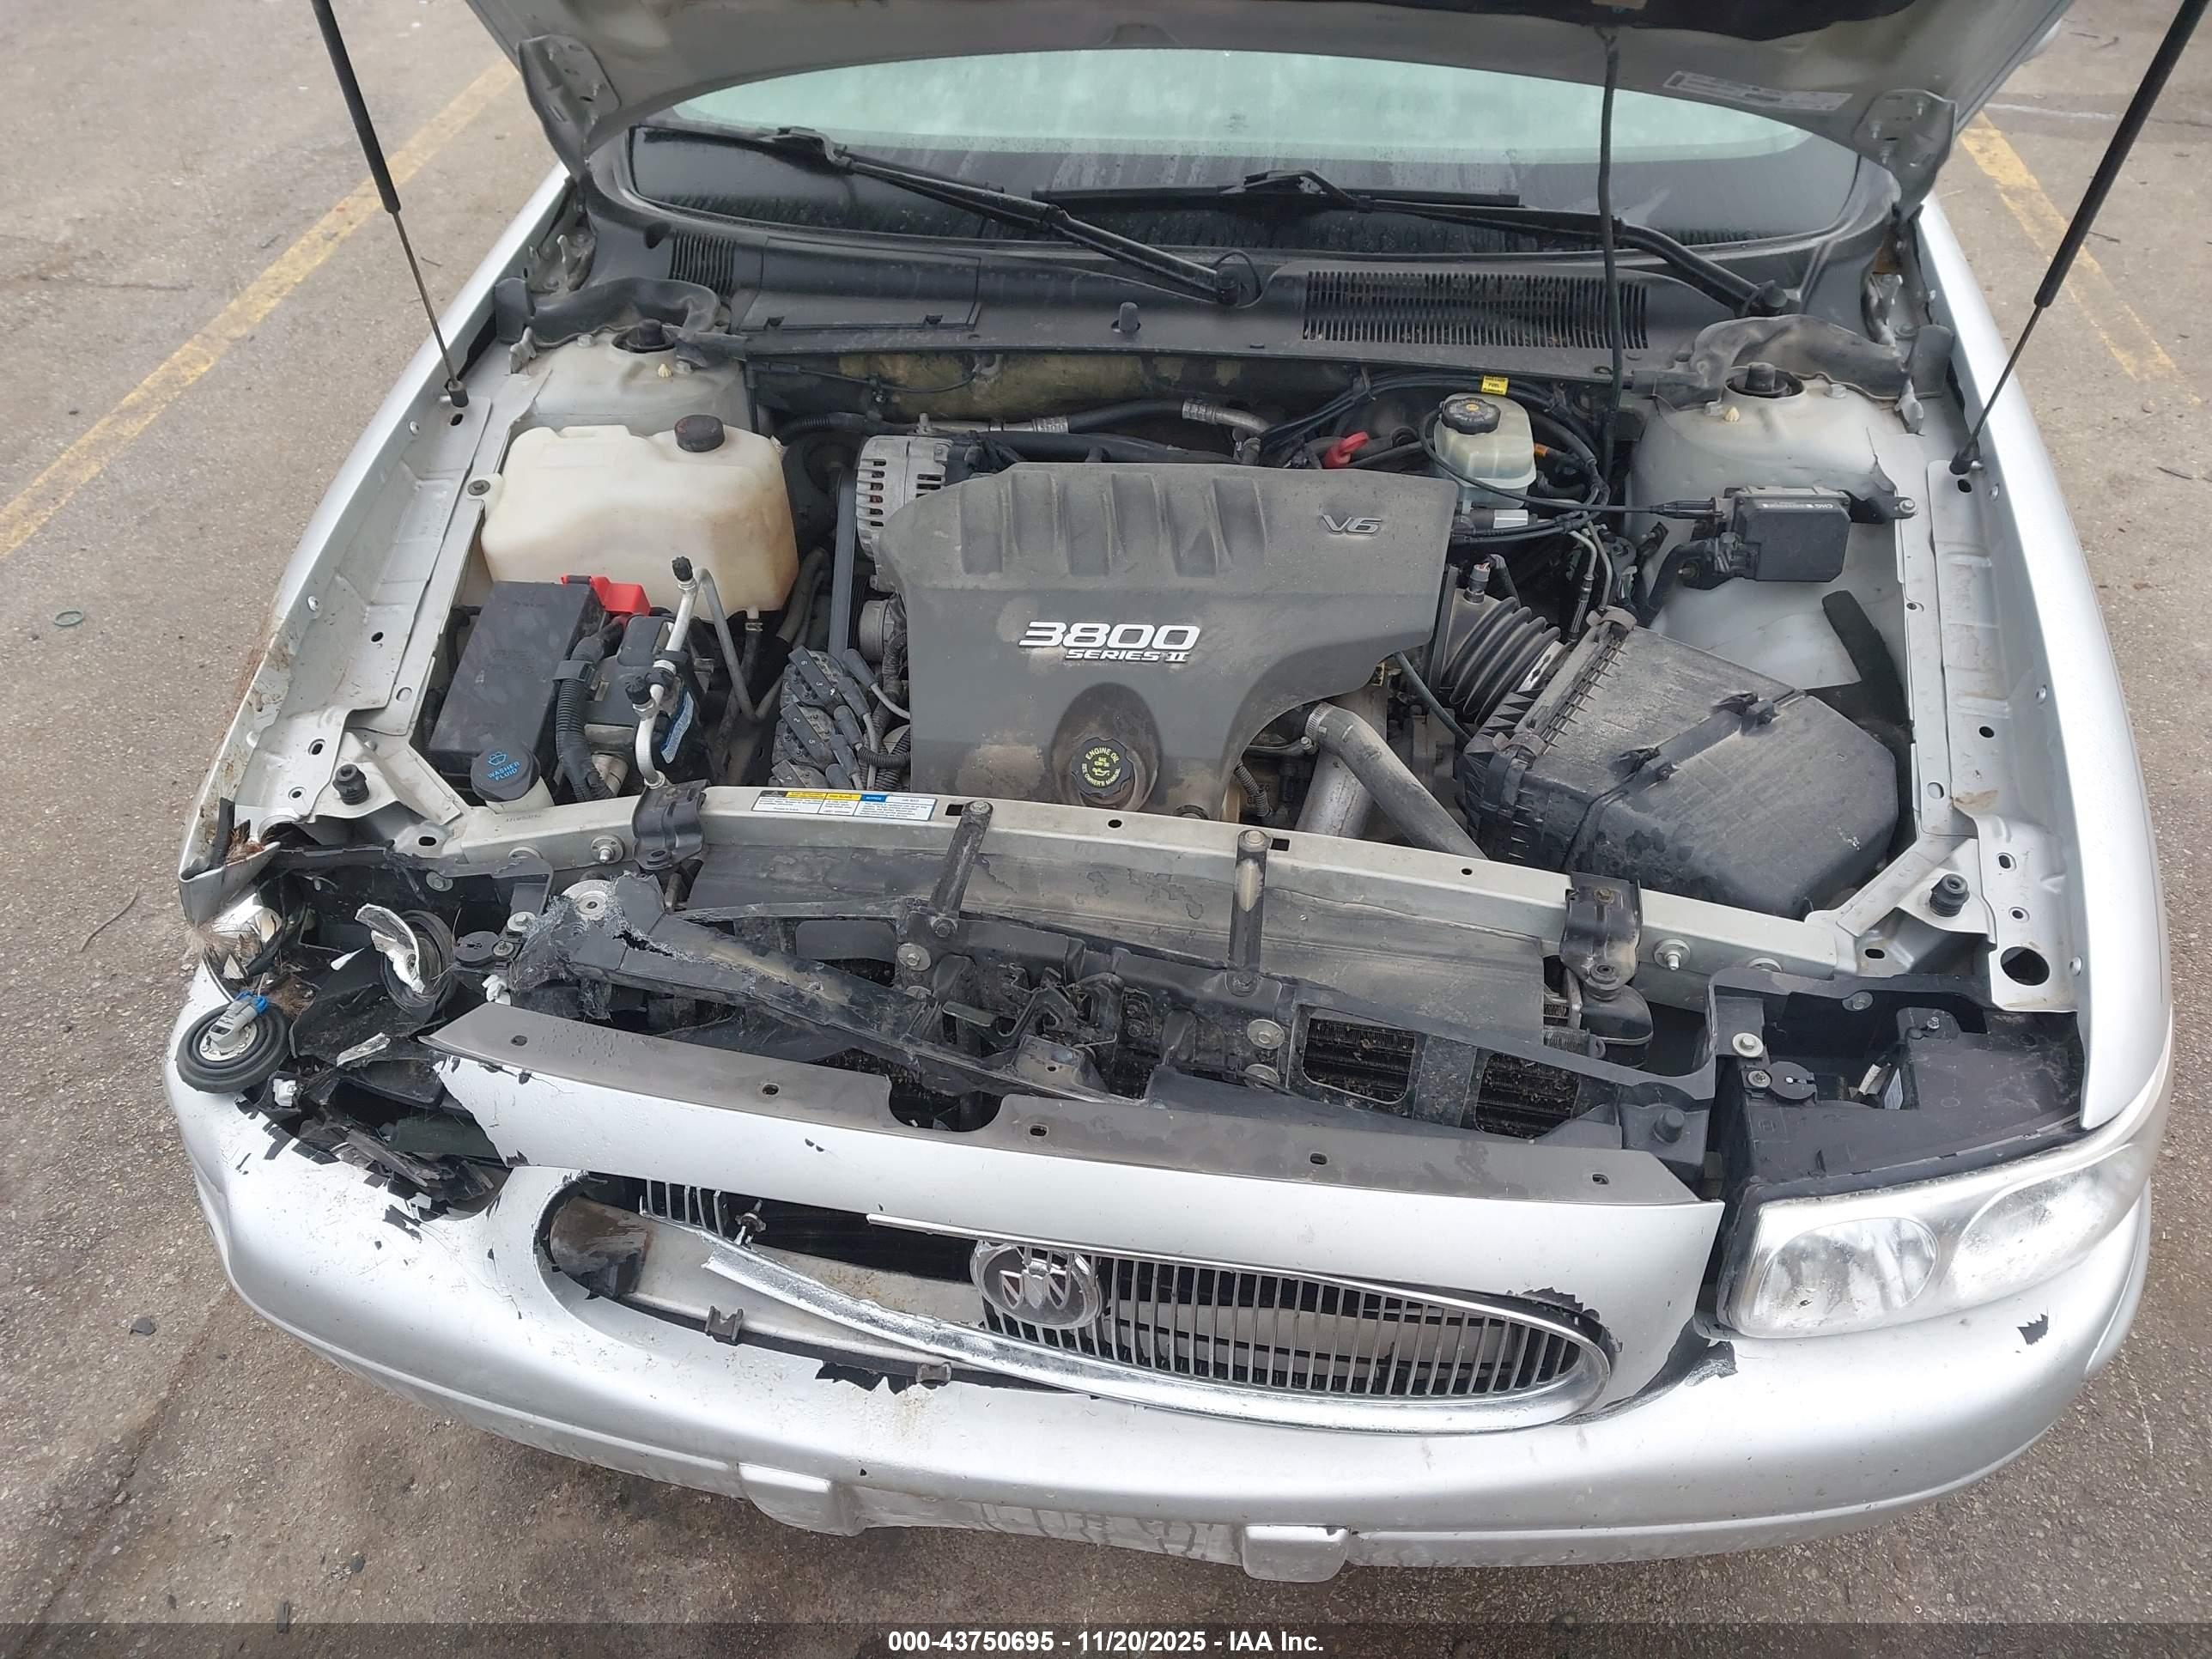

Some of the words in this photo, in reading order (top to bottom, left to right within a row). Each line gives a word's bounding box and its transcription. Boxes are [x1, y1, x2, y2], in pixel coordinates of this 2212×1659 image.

[1322, 514, 1382, 534] V6
[1018, 621, 1200, 650] 3800
[1065, 649, 1160, 662] SERIES
[1165, 651, 1190, 662] II
[1085, 747, 1111, 760] ENGINE
[1110, 752, 1120, 763] OIL
[487, 761, 520, 778] WASHER
[495, 768, 518, 781] FLUID
